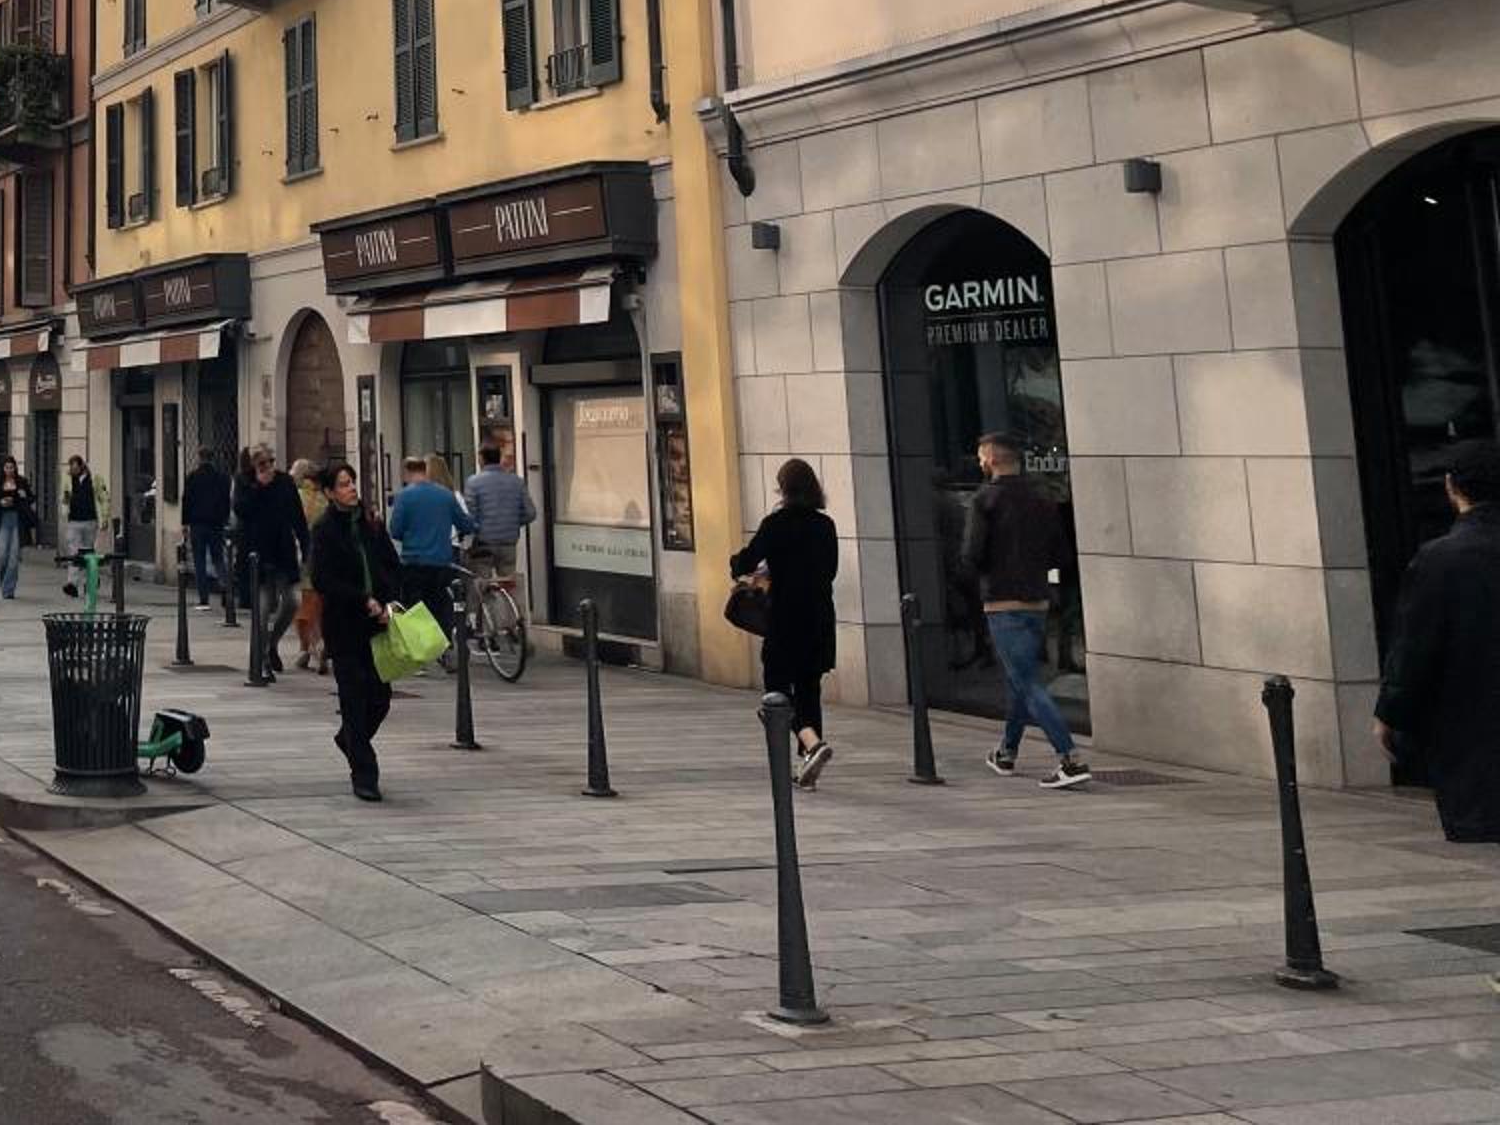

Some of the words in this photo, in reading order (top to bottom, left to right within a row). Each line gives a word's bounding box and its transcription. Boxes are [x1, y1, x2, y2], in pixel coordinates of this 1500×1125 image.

[495, 196, 549, 243] PATTINI
[925, 275, 1044, 312] GARMIN
[927, 322, 989, 347] PREMIUM
[996, 316, 1049, 342] DEALER
